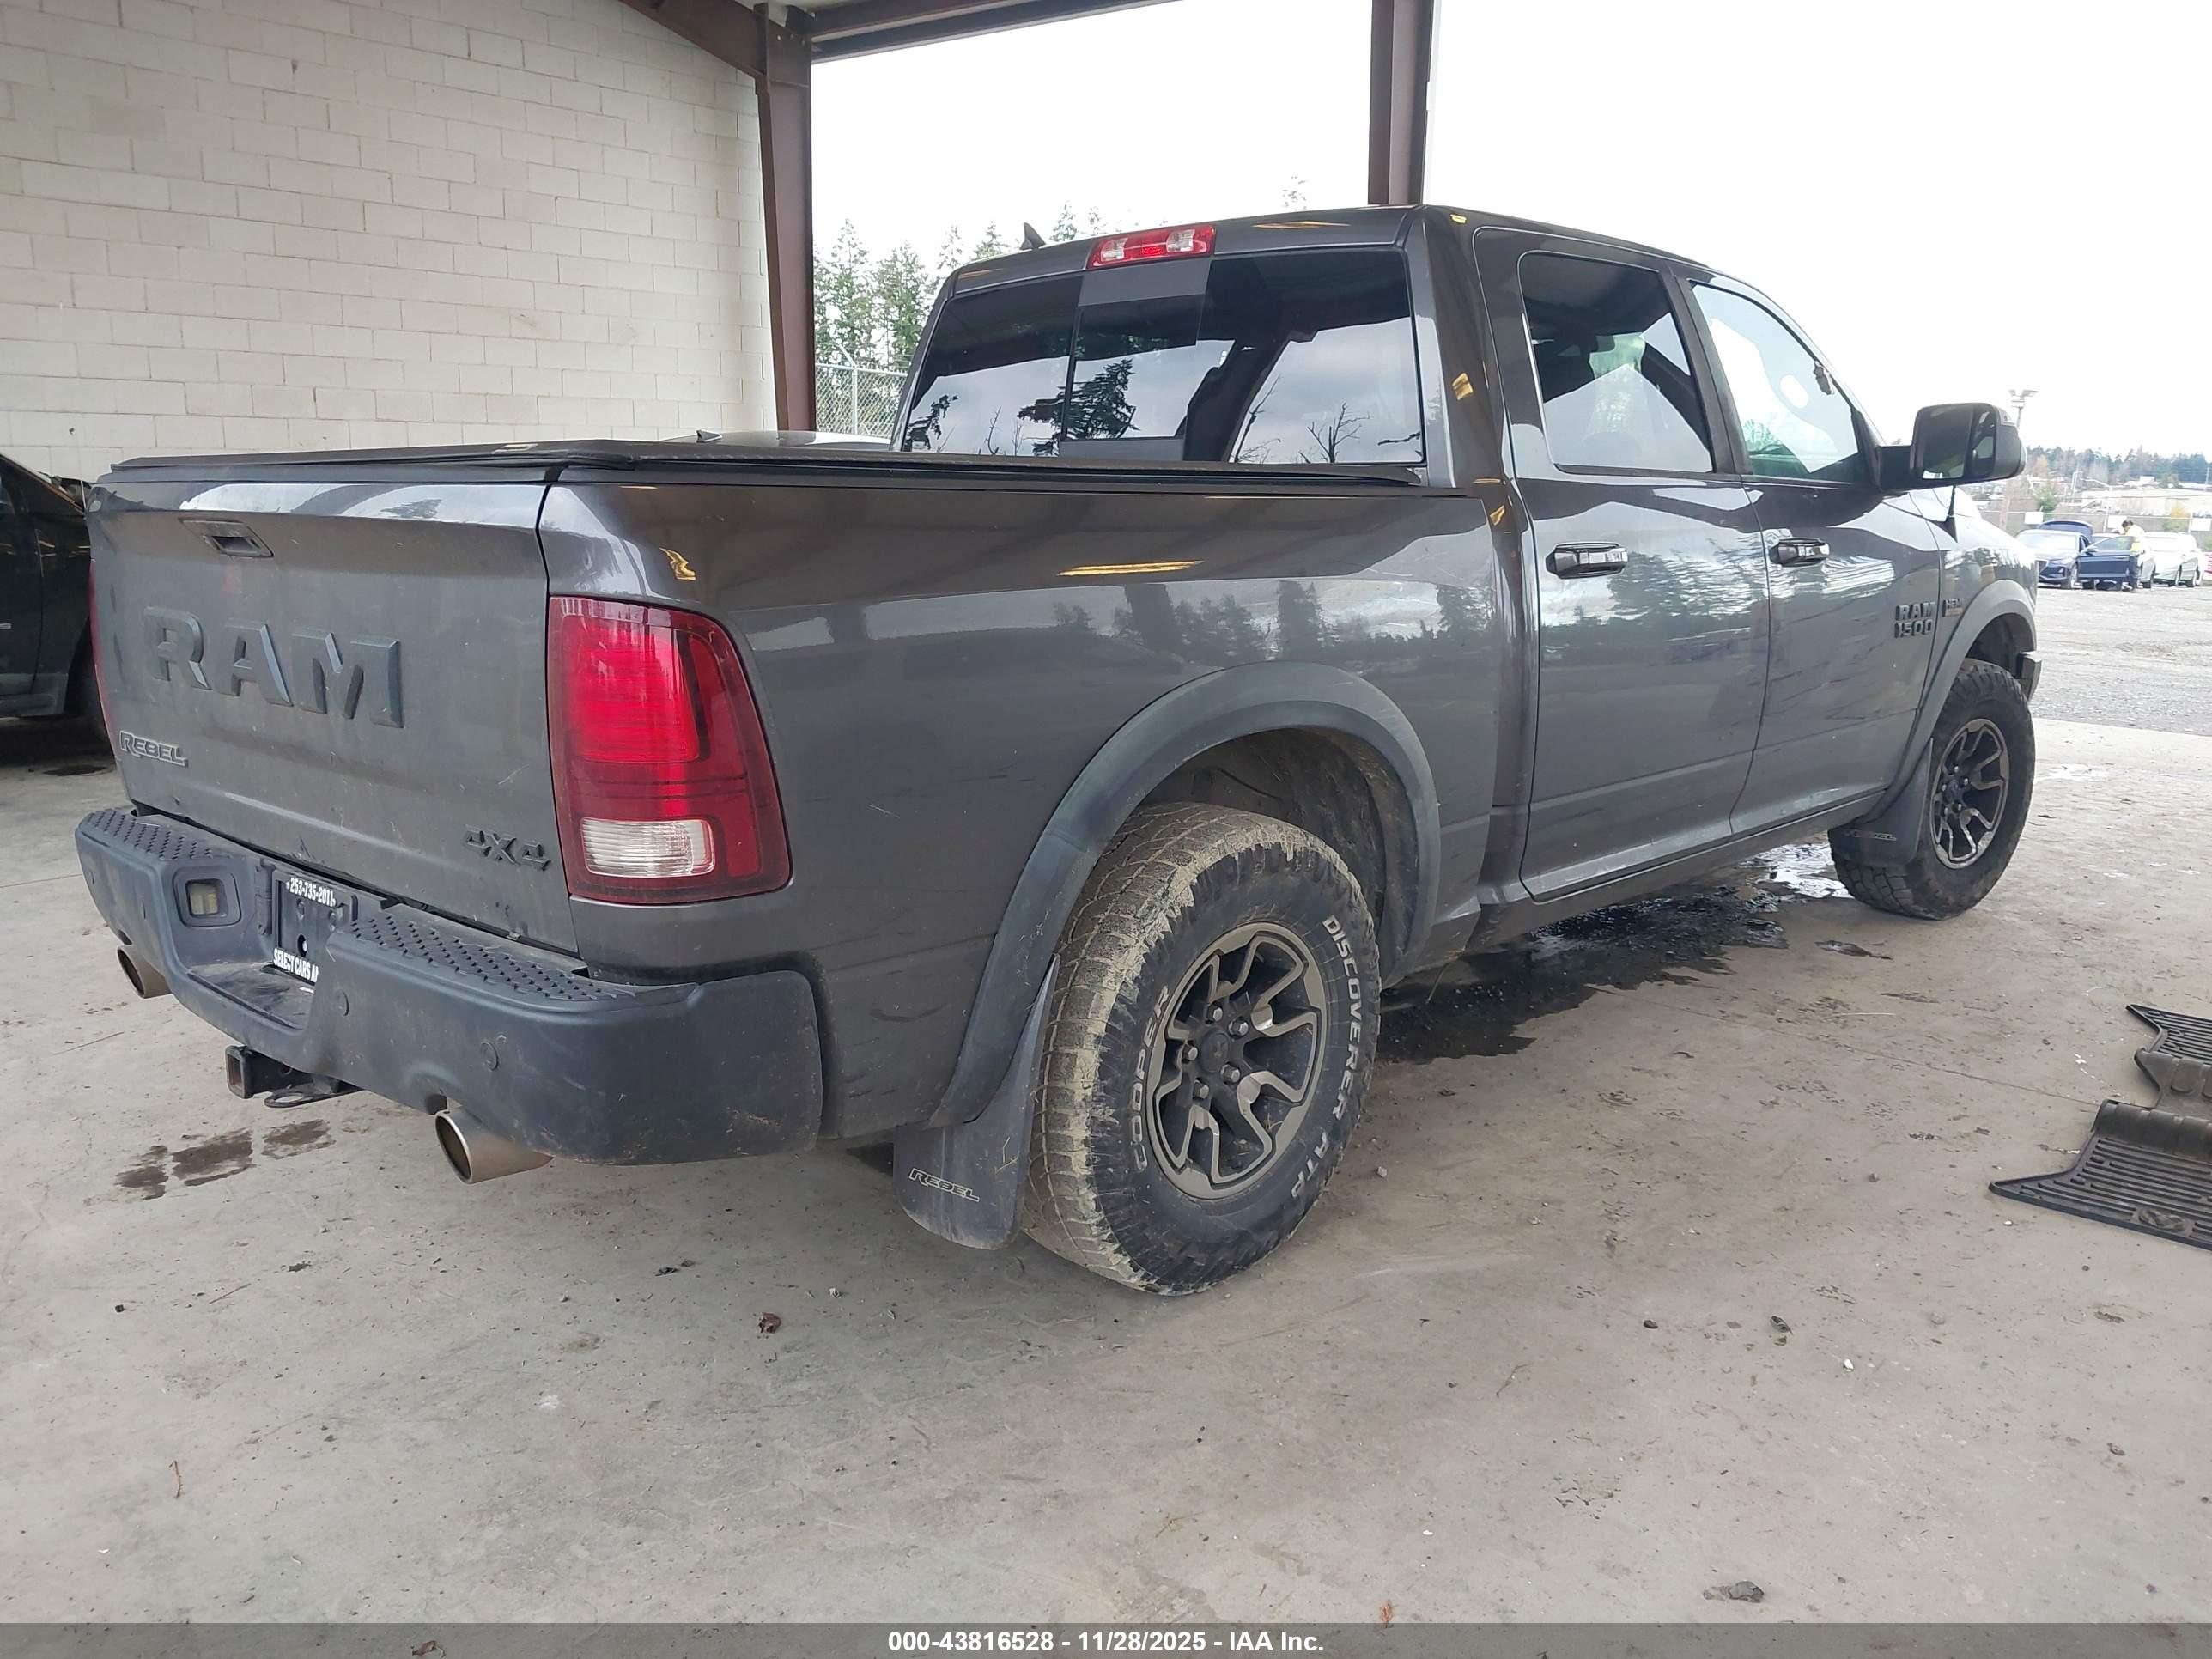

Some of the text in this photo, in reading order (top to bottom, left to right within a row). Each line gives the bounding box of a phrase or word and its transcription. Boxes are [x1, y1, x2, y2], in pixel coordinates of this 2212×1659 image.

[1894, 619, 1933, 638] 1500
[1895, 601, 1937, 620] RAM
[143, 606, 404, 729] RAM
[119, 730, 188, 768] REBEL
[274, 948, 295, 972] SELECT
[295, 957, 311, 979] CARS
[1322, 915, 1363, 1121] DISCOVERER
[1132, 986, 1169, 1171] COOPER
[908, 1168, 980, 1202] REBEL
